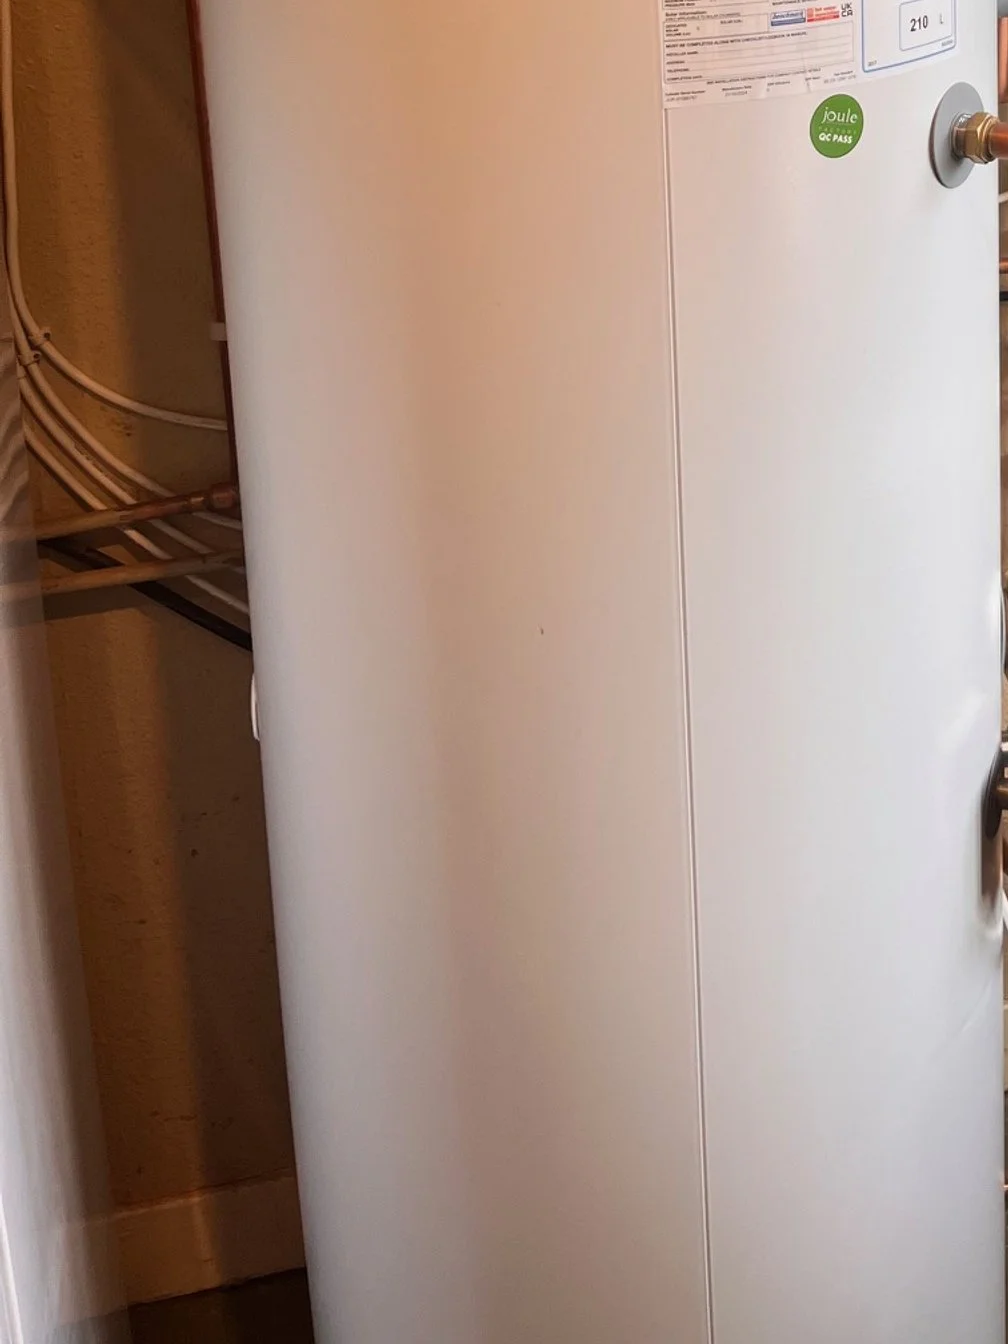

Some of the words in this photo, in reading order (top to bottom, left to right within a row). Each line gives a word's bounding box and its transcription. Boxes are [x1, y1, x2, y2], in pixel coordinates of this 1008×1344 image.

[910, 15, 928, 32] 210
[821, 107, 858, 124] joule
[818, 132, 832, 142] QC
[832, 134, 853, 144] PASS
